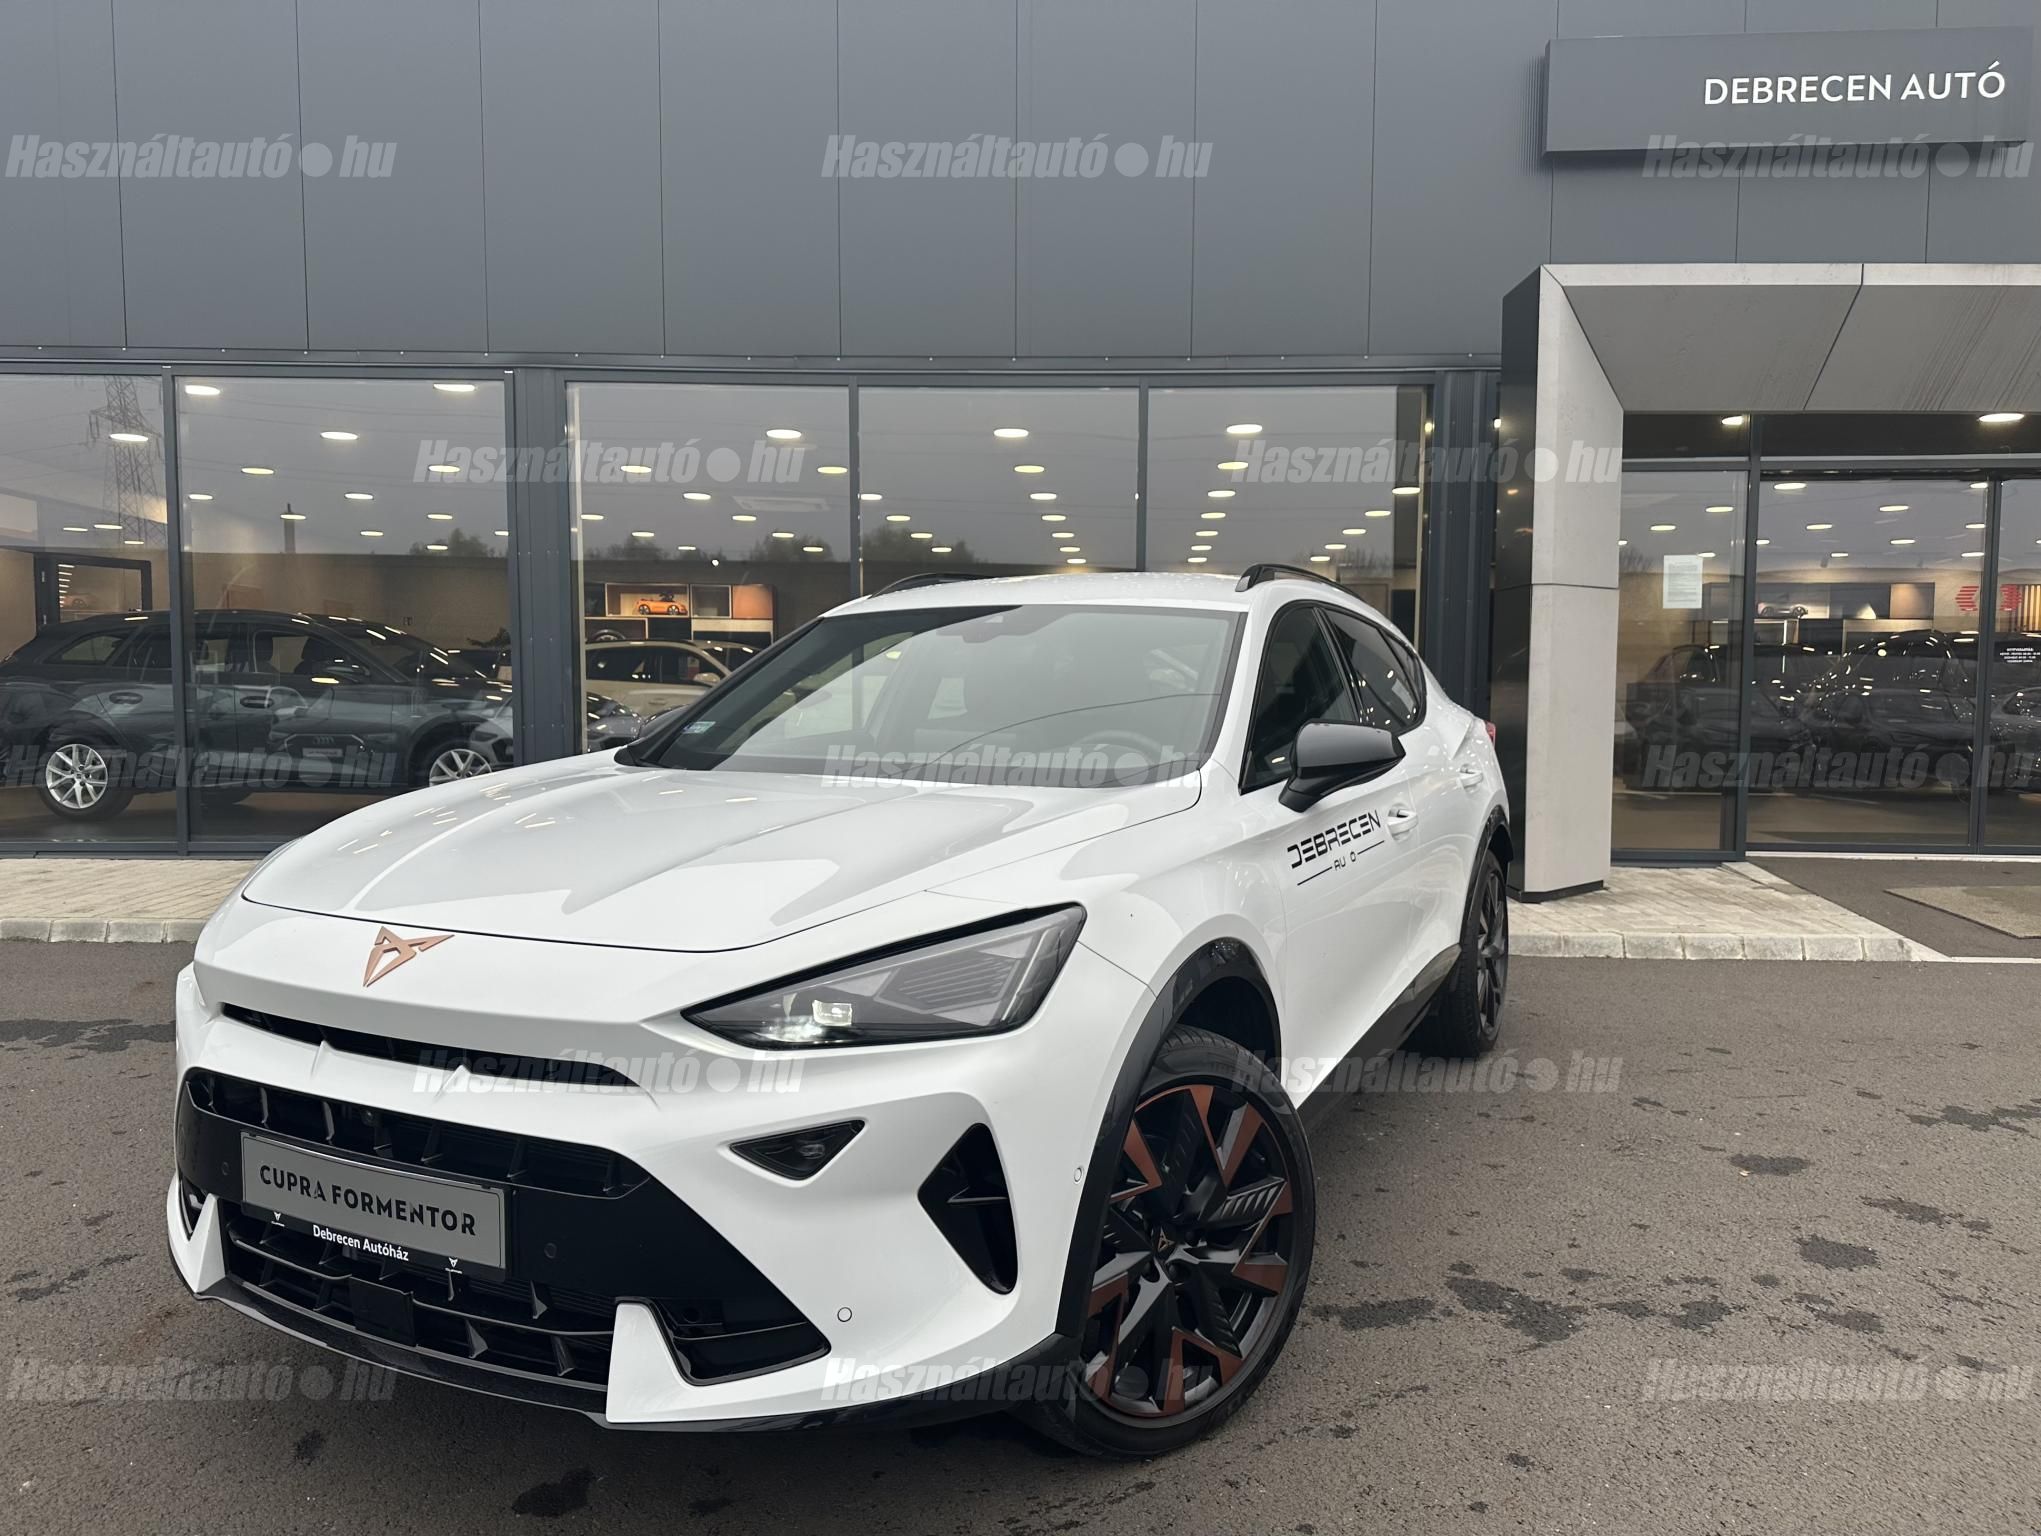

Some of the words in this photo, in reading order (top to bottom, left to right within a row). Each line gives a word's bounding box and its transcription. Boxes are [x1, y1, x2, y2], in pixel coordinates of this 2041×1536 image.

[1704, 74, 1892, 105] DEBRECEN
[1900, 60, 2006, 100] AUTÓ
[1287, 810, 1381, 869] DEBRECEN
[259, 1164, 327, 1201] CUPRA
[332, 1184, 476, 1236] FORMENTOR
[313, 1224, 361, 1249] Debrecen
[362, 1238, 409, 1261] Autóház
